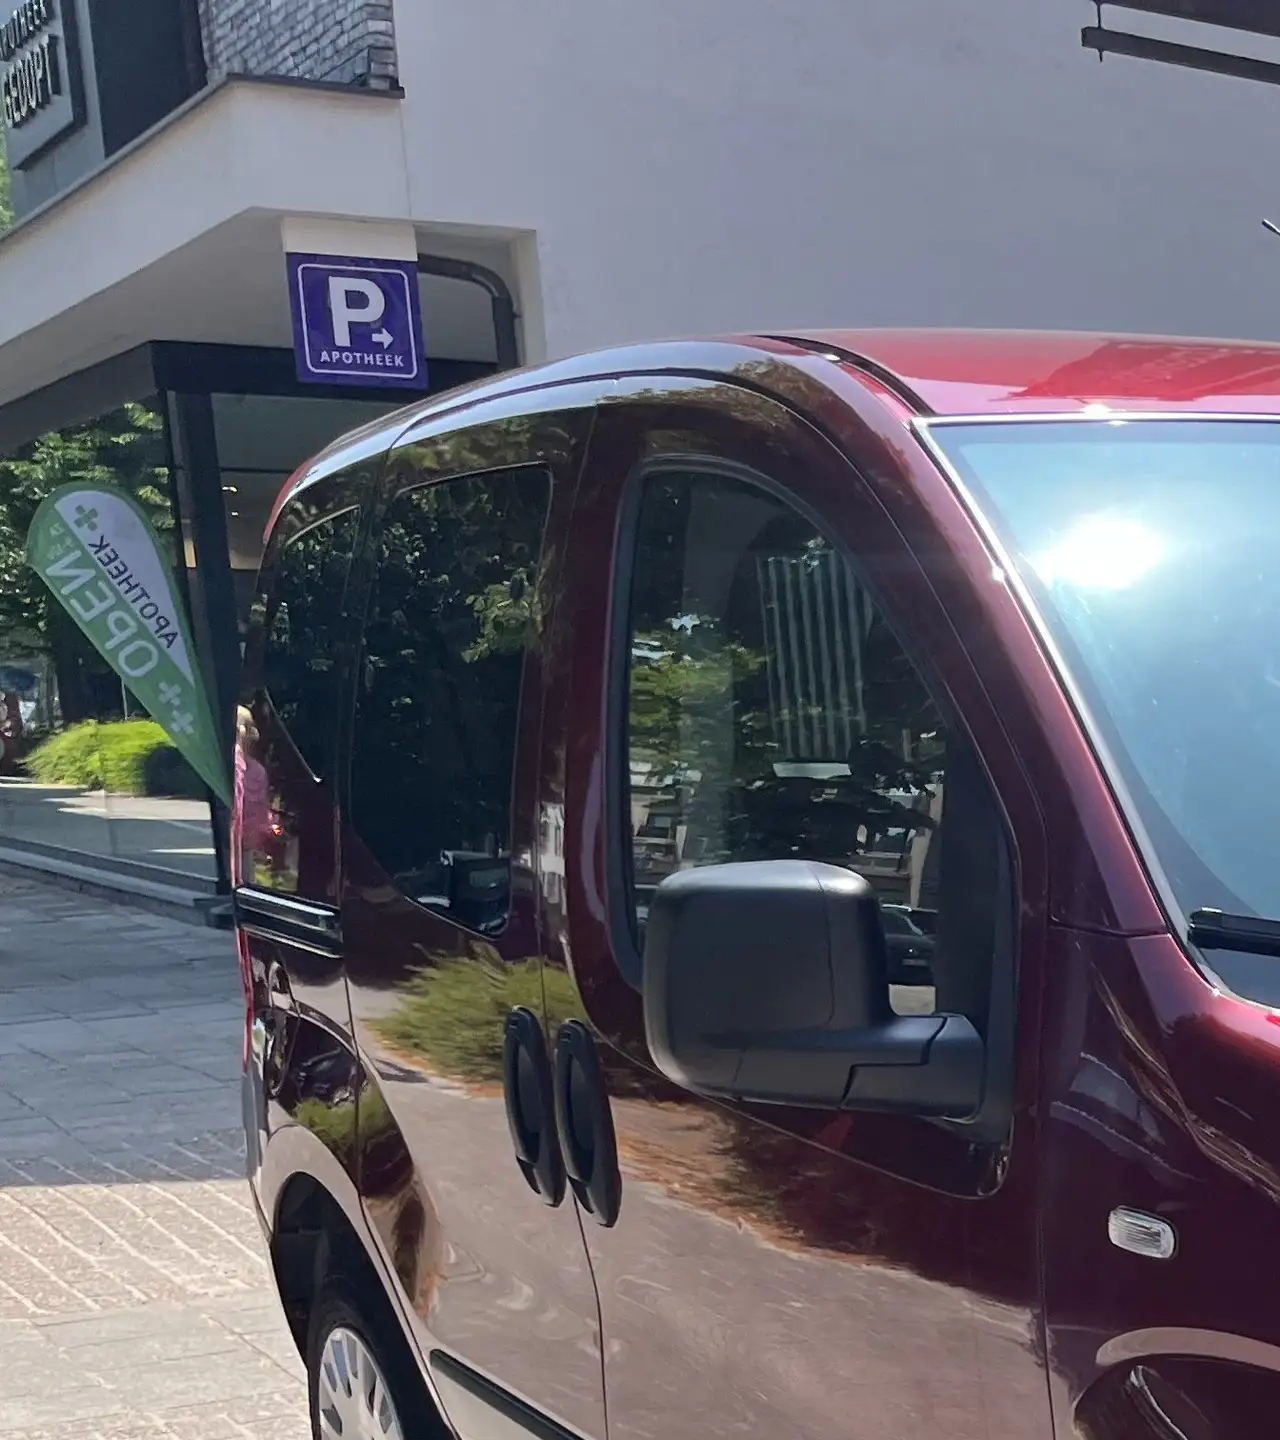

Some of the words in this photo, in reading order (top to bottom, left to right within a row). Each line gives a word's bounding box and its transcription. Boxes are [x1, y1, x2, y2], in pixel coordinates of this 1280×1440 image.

[0, 0, 47, 60] POTHEEK
[328, 276, 385, 347] P
[320, 350, 404, 367] APOTHEEK
